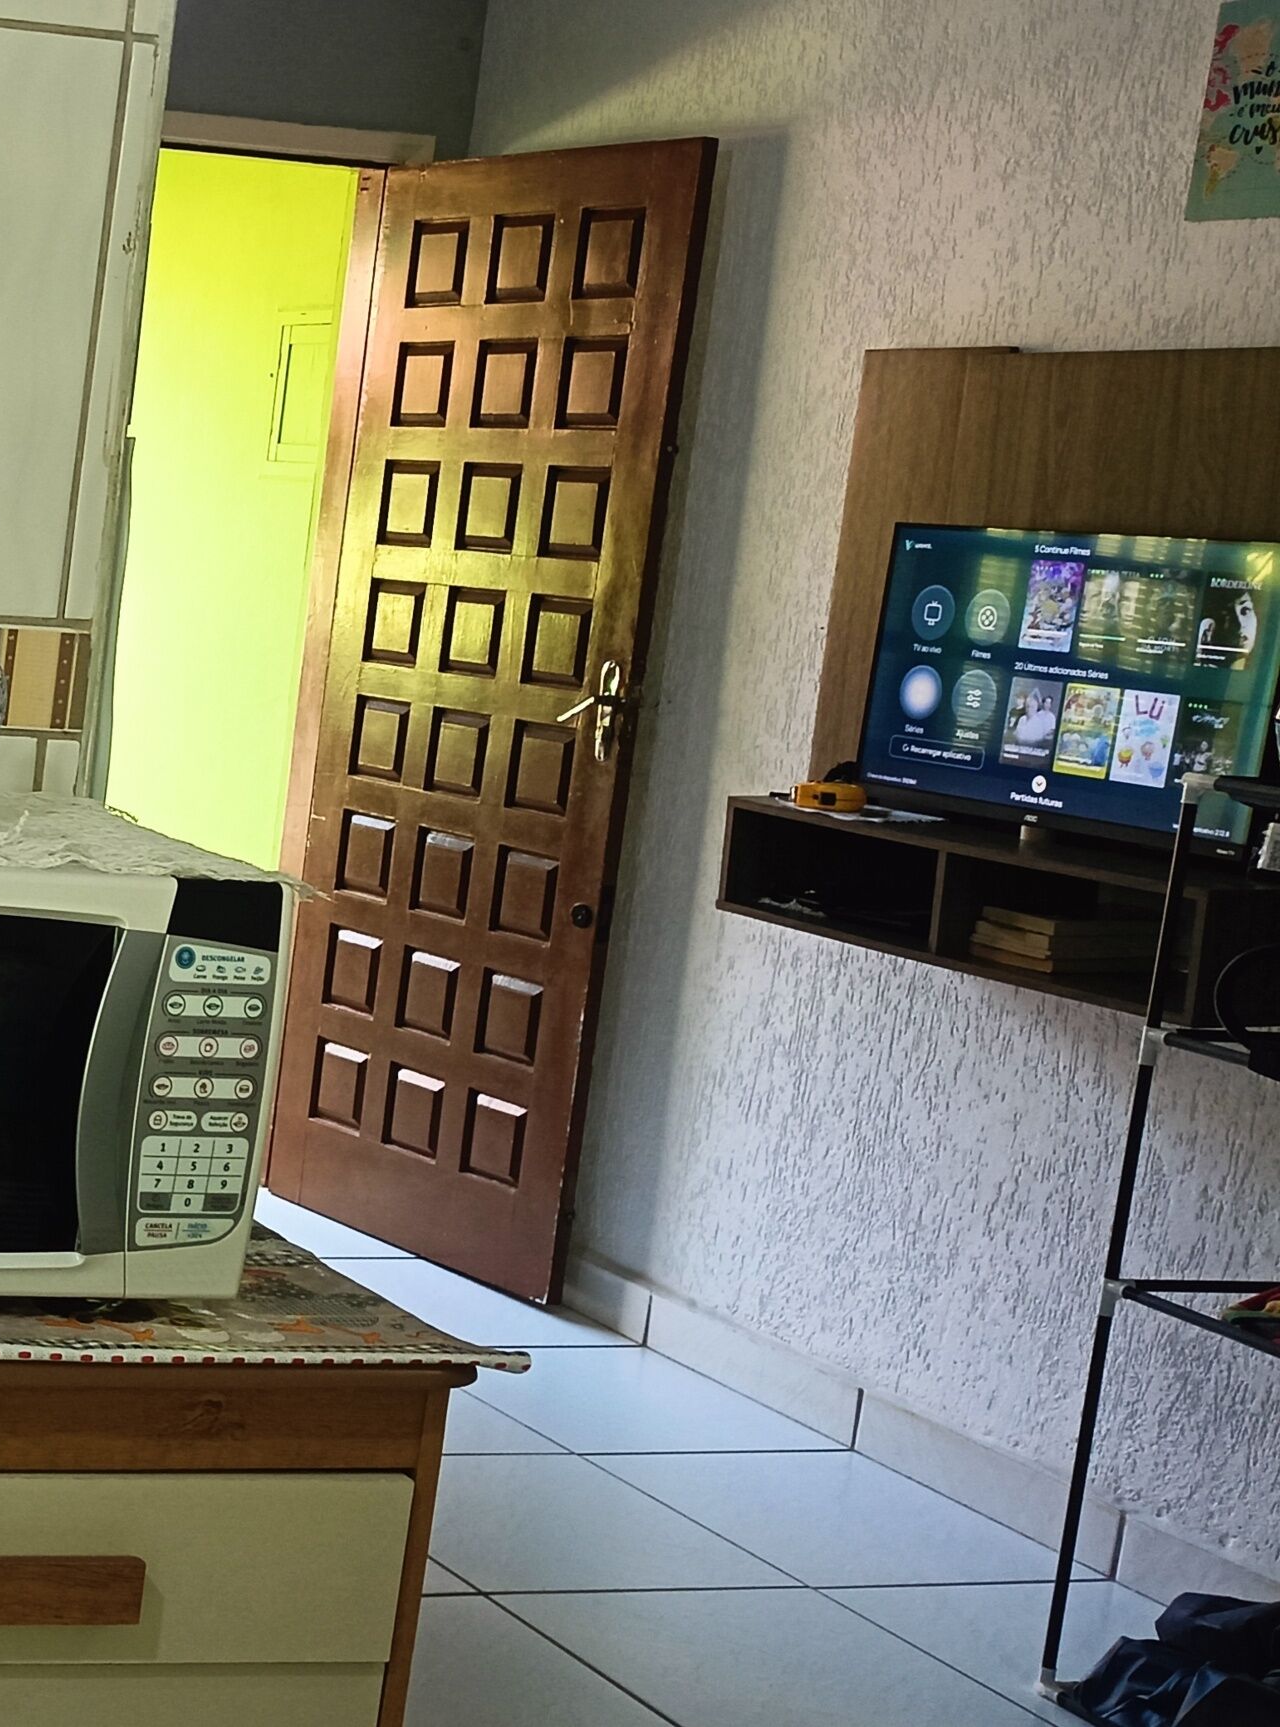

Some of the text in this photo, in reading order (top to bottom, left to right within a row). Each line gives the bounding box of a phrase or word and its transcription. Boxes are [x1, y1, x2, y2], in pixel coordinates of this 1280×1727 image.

[1040, 545, 1069, 554] Continue
[1070, 546, 1091, 556] Filmes
[971, 649, 992, 659] Filmes
[1014, 661, 1023, 670] 20
[1048, 666, 1087, 678] adicionados
[955, 729, 979, 740] Ajustes
[942, 750, 972, 762] aplicativo
[1010, 791, 1063, 809] Partidas futuras
[201, 955, 245, 963] DESCONGELAR
[160, 1142, 233, 1153] 1 2 3
[156, 1160, 230, 1172] 4 5 6
[154, 1178, 227, 1189] 7 8 9
[184, 1197, 191, 1207] 0
